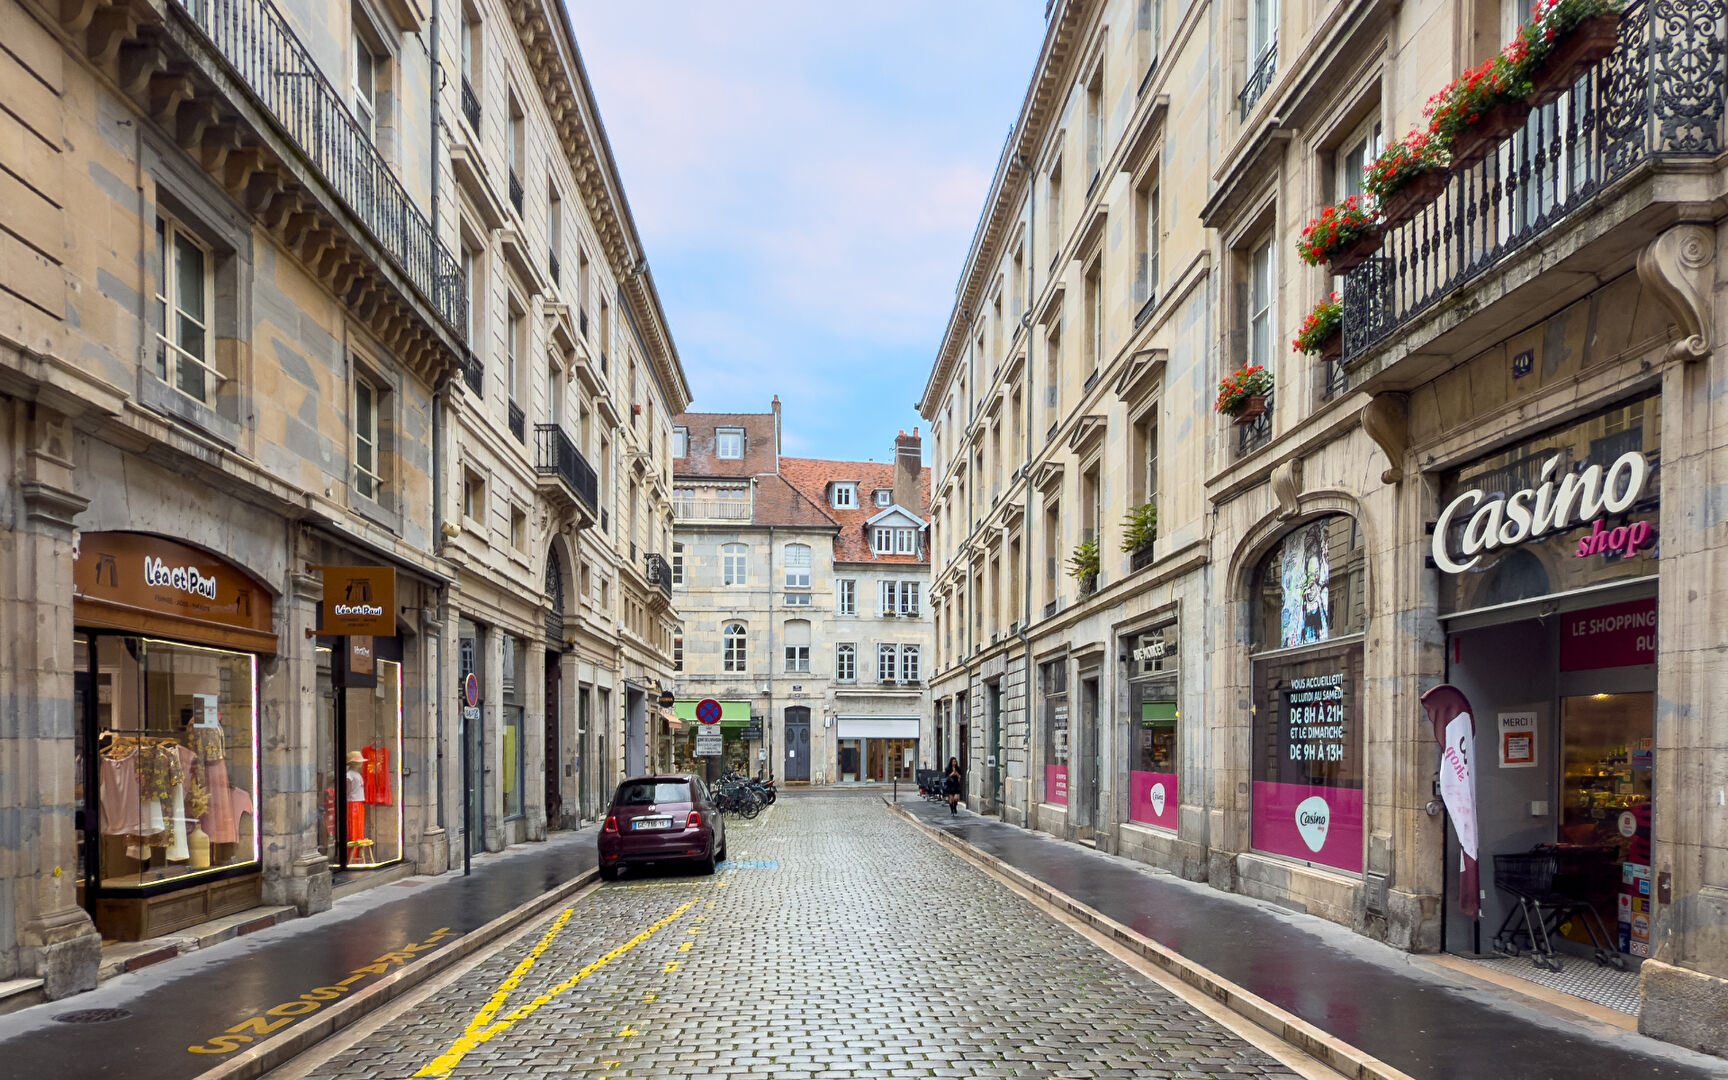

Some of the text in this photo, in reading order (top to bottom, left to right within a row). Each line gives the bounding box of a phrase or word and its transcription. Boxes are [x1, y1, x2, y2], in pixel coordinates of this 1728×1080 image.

[1432, 452, 1648, 574] Casino
[1575, 519, 1652, 558] shop
[145, 556, 216, 600] Léa et Paul
[362, 605, 382, 616] Paul
[1572, 610, 1656, 637] LE SHOPPING
[1291, 673, 1343, 689] VOUS ACCUEILLENT
[1290, 688, 1343, 703] DU LUNDI AU SAMEDI
[1290, 701, 1343, 724] DE 8H À 21H
[1503, 717, 1528, 727] MERCI
[1290, 725, 1343, 739] ET LE DIMANCHE
[1290, 739, 1343, 761] DE 9H À 13H
[1300, 811, 1326, 826] Casino
[187, 927, 457, 1054] LIVRAISONS
